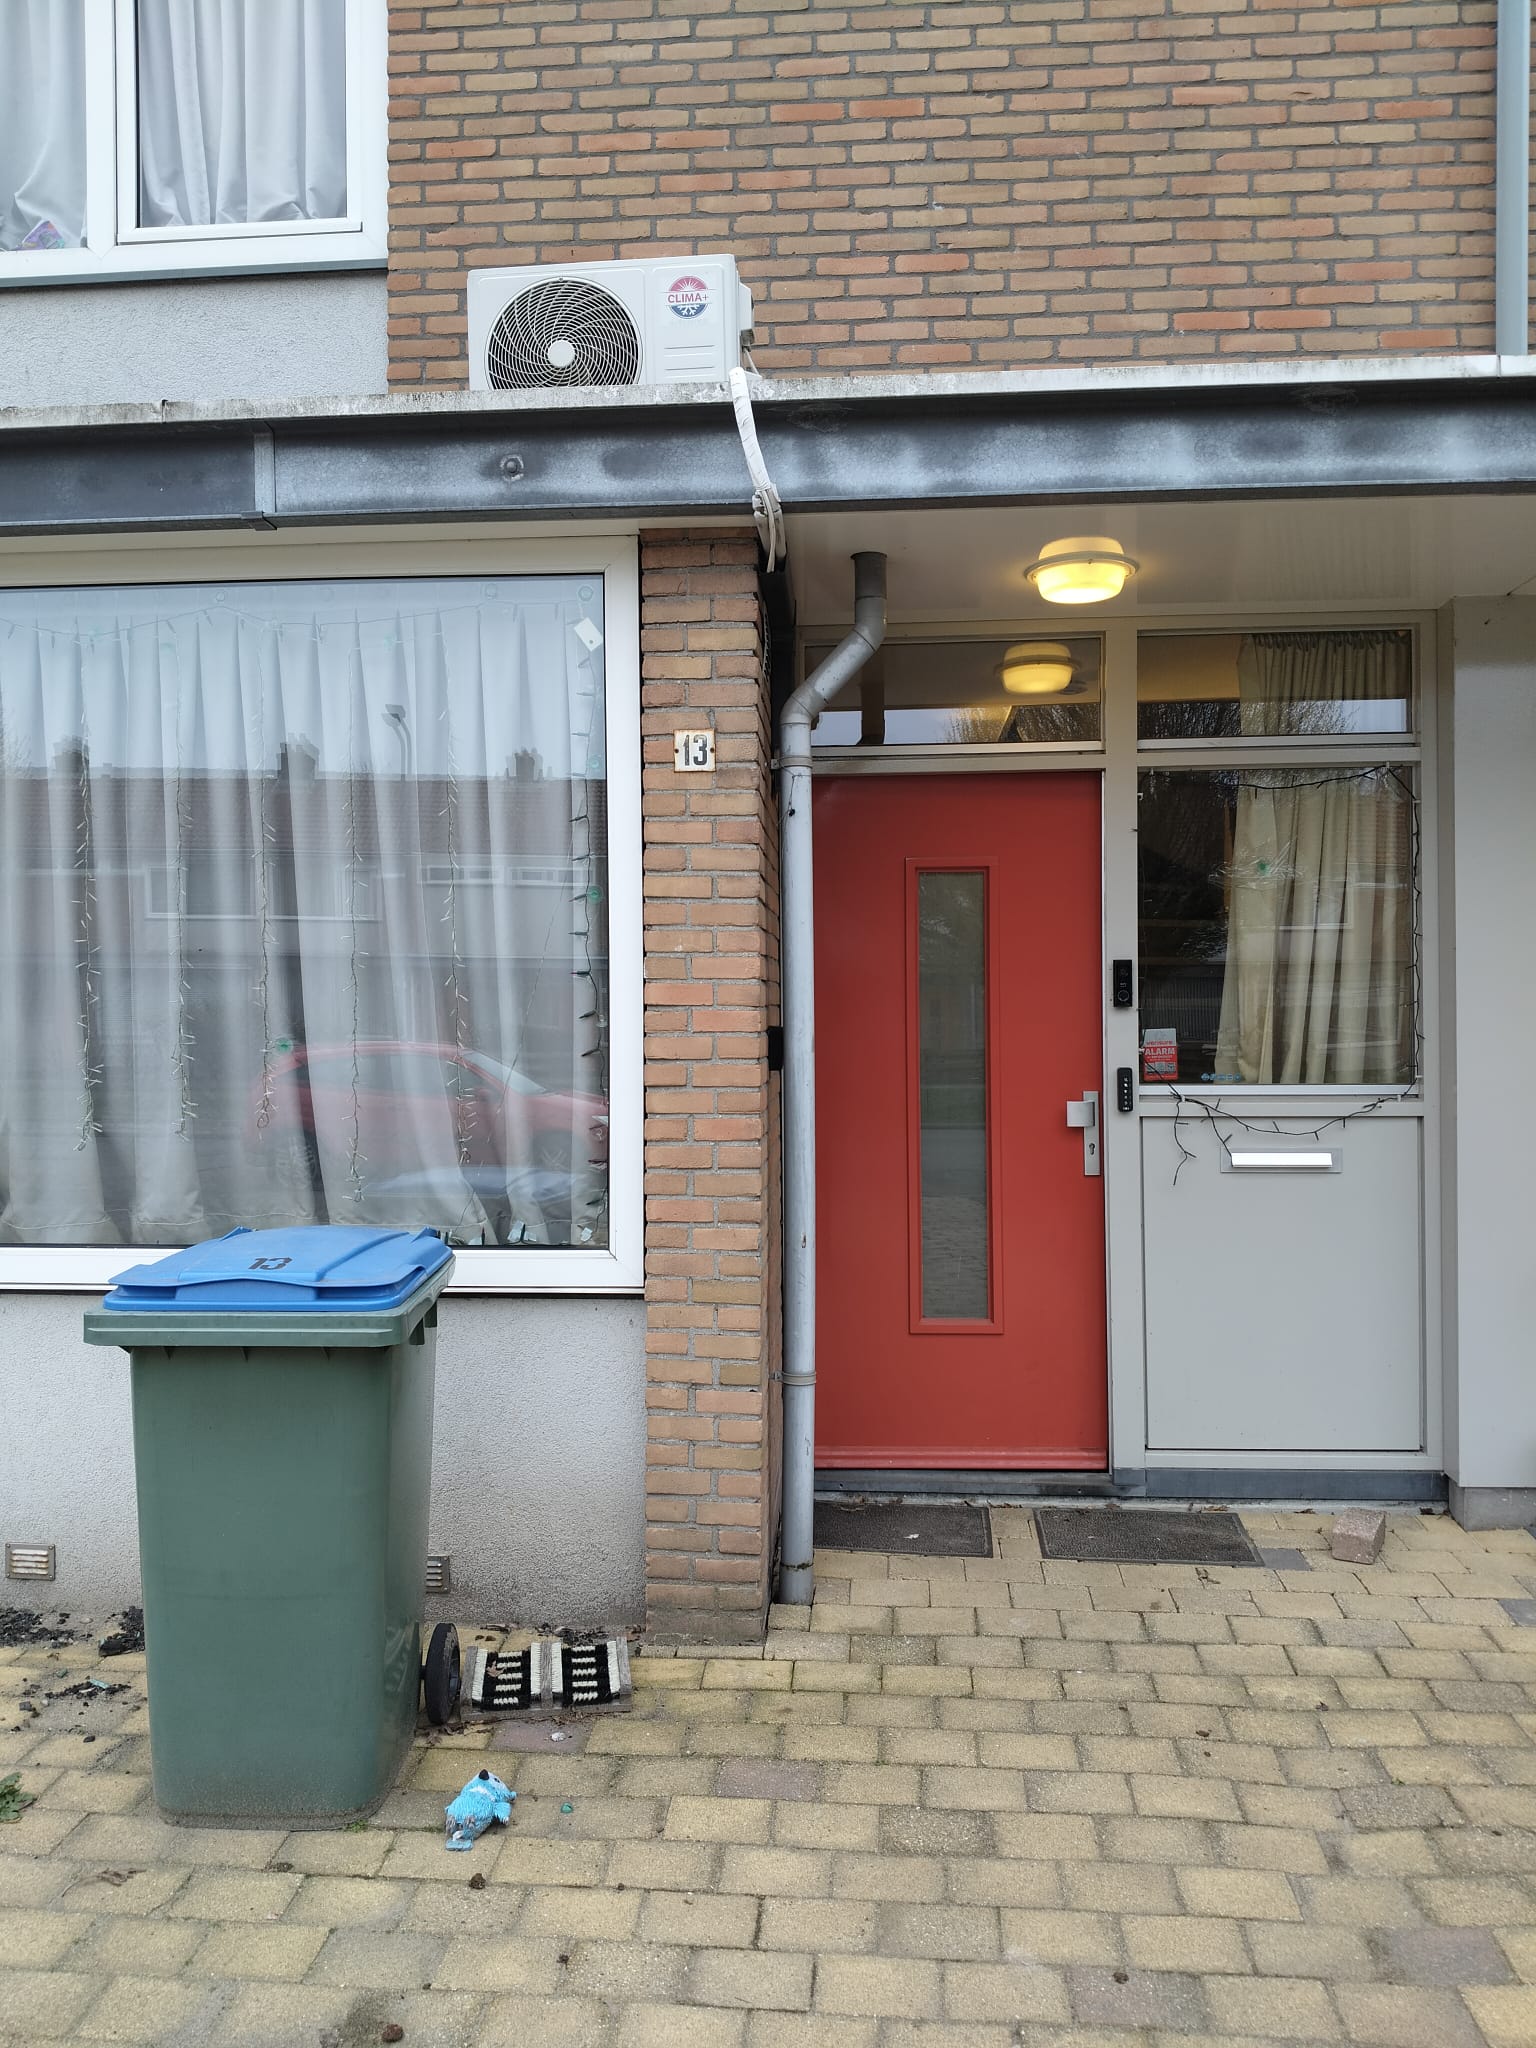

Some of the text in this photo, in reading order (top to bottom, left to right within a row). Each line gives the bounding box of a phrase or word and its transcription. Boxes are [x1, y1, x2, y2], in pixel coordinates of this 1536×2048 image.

[667, 292, 709, 304] CLIMA+
[682, 733, 708, 766] 13
[1144, 1047, 1175, 1056] ALARM
[247, 1257, 293, 1271] 13
